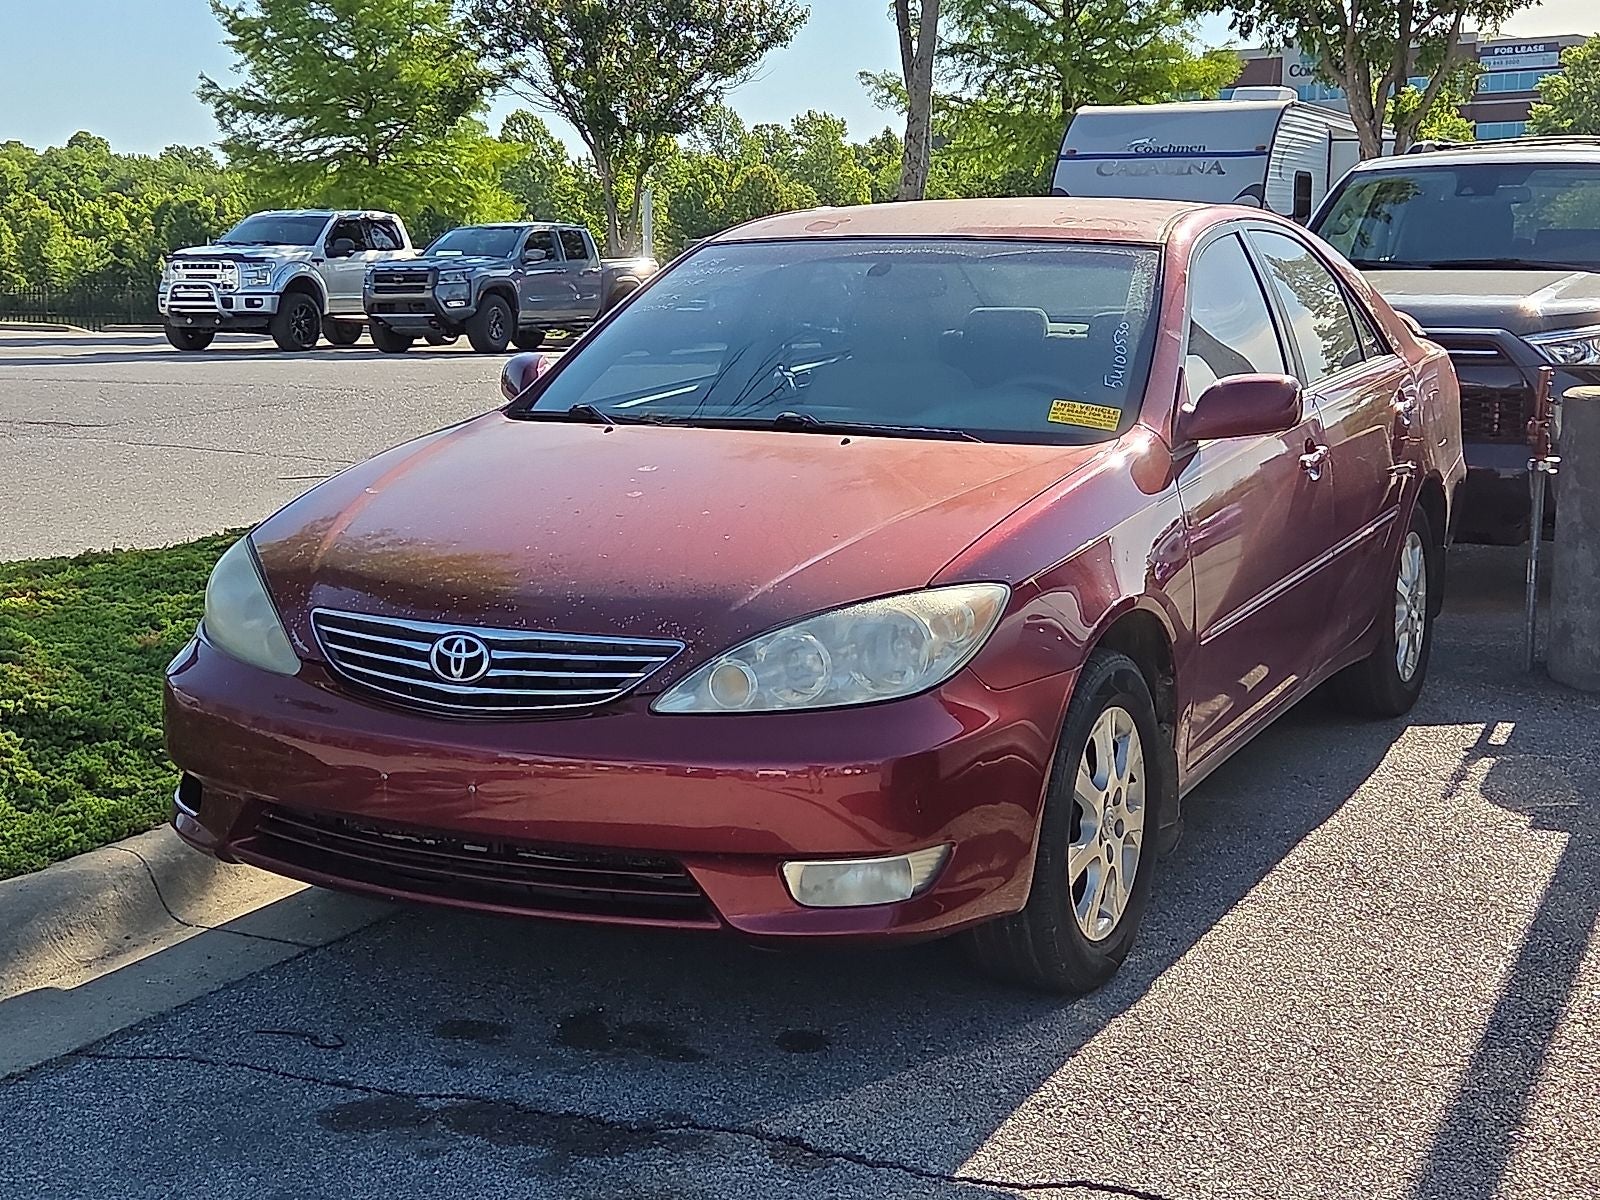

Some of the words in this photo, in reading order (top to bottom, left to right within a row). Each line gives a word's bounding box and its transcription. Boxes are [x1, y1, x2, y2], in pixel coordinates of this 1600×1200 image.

[1494, 47, 1513, 55] FOR
[1514, 44, 1545, 54] LEASE
[1134, 143, 1206, 154] Coachmen
[1096, 159, 1226, 177] CATALINA
[1055, 401, 1076, 409] THIS
[1079, 404, 1119, 416] VEHICLE
